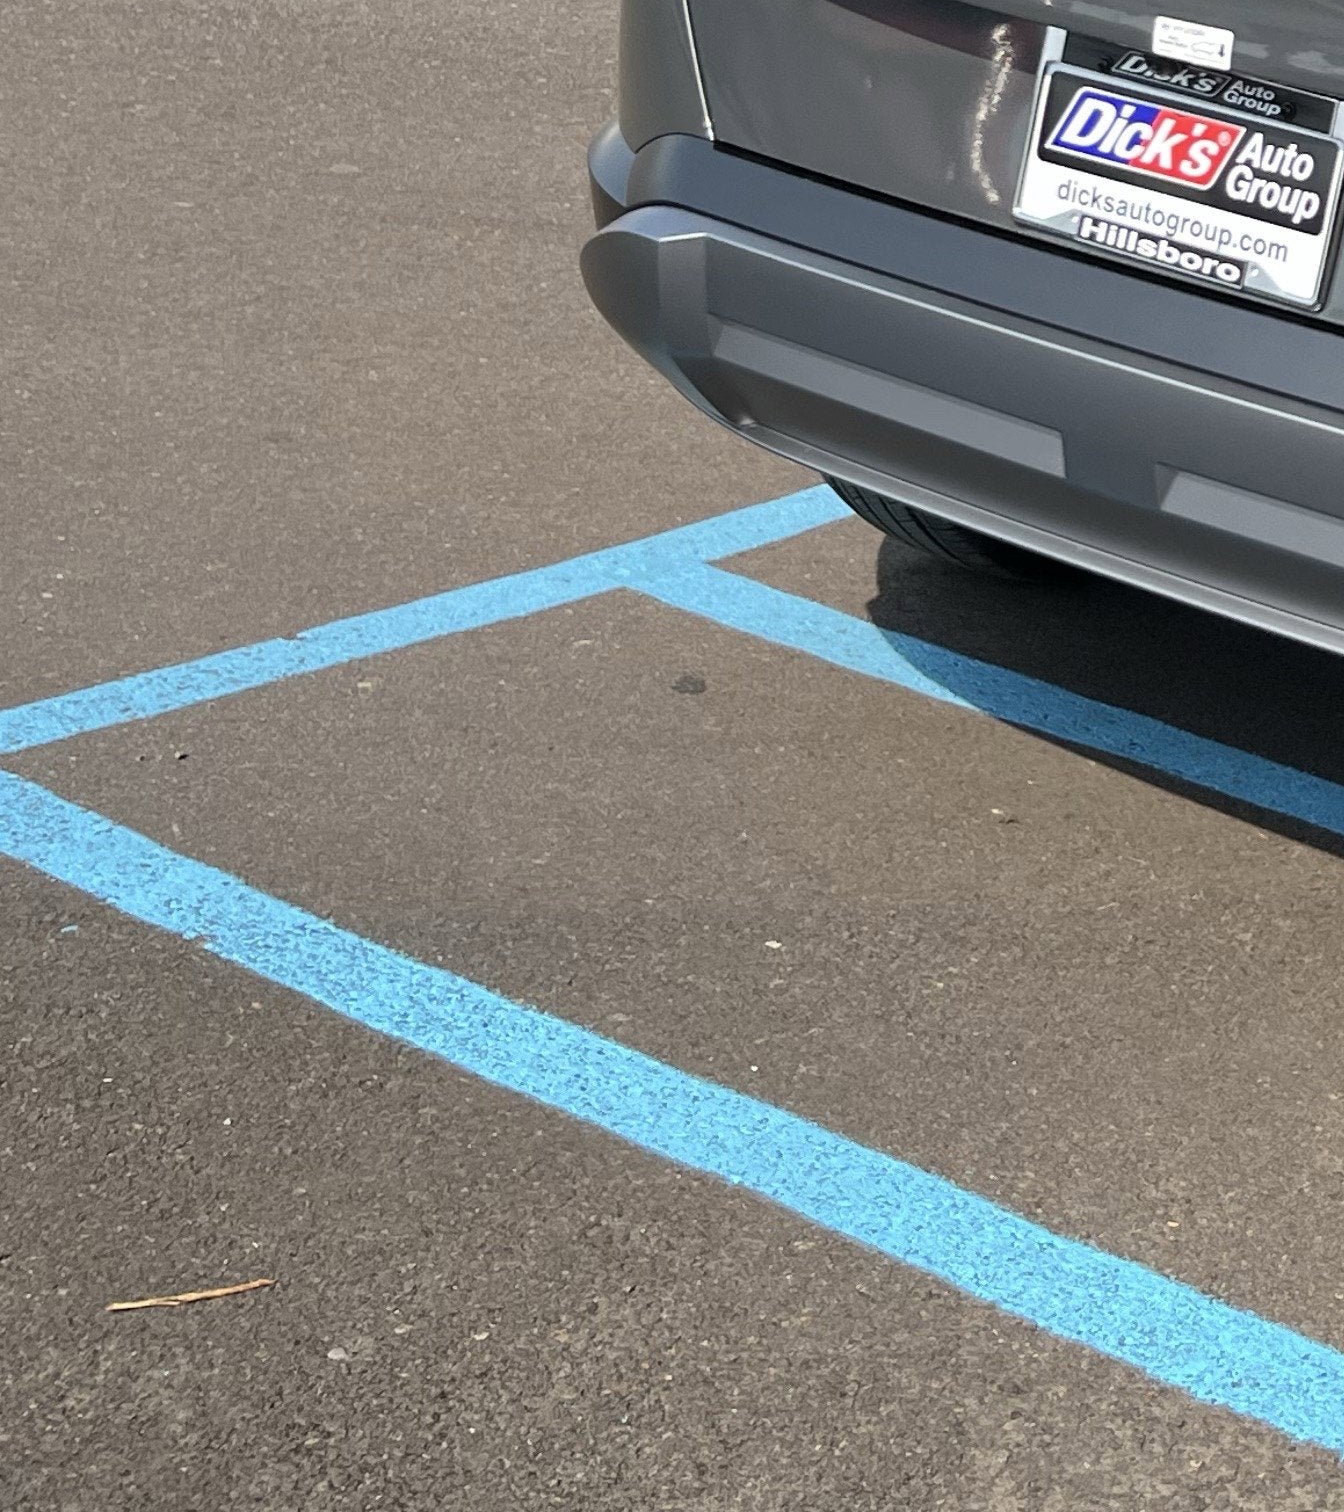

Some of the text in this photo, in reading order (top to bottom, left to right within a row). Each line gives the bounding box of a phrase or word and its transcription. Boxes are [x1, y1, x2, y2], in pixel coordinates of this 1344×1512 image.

[1223, 90, 1283, 117] Group
[1231, 78, 1277, 102] Auto
[1235, 132, 1315, 181] Auto
[1056, 178, 1289, 264] dicksautogroup.com
[1225, 165, 1321, 225] Group
[1078, 215, 1242, 284] Hillsboro
